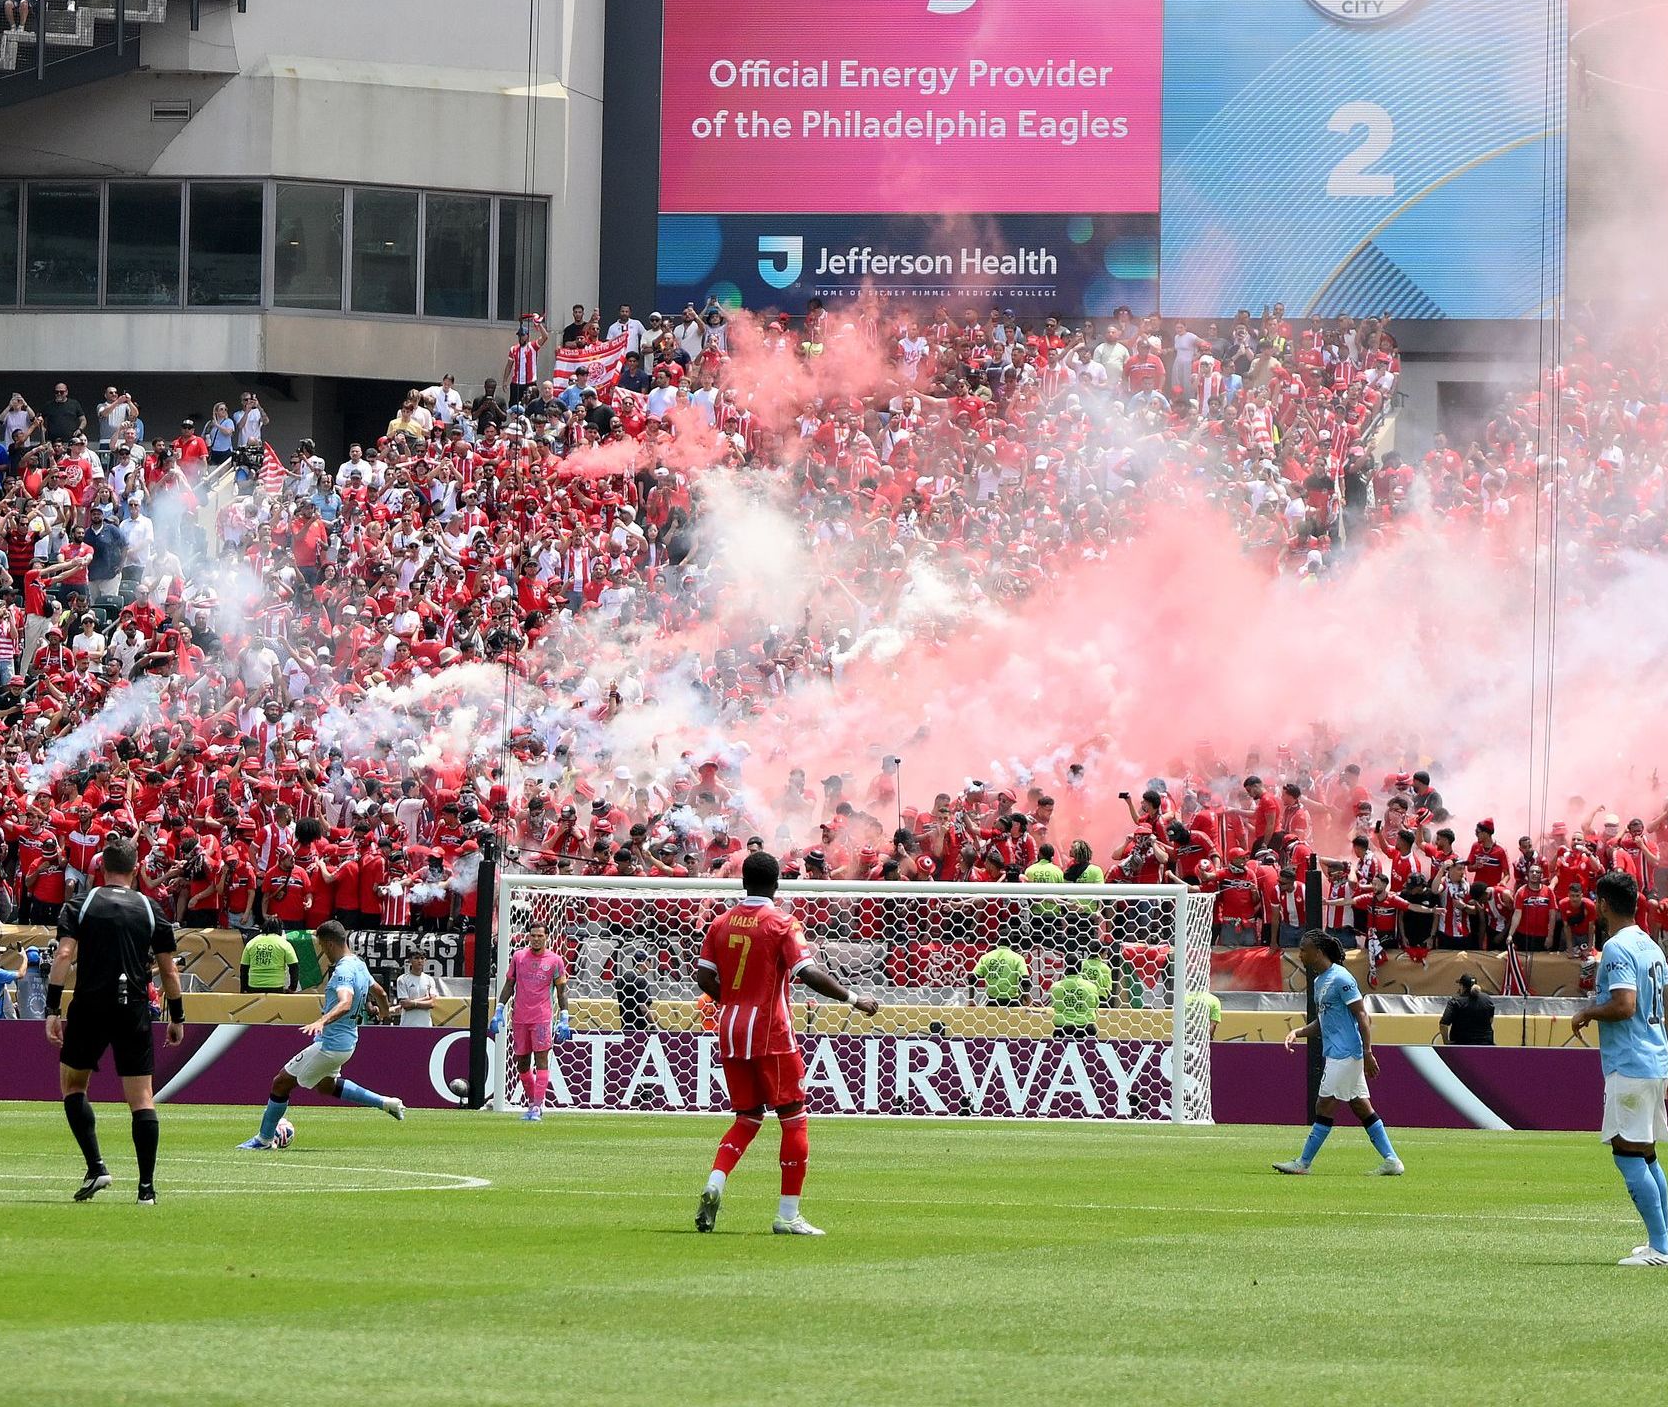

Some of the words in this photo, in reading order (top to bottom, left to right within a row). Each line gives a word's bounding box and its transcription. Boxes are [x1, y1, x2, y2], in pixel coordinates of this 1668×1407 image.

[709, 57, 830, 89] Official
[839, 59, 959, 95] Energy
[968, 58, 1114, 89] Provider
[691, 110, 728, 139] of
[733, 110, 795, 139] the
[801, 109, 1008, 146] Philadelphia
[1015, 110, 1129, 146] Eagles
[1325, 100, 1396, 197] 2
[815, 245, 956, 277] Jefferson
[959, 246, 1058, 275] Health
[728, 914, 759, 928] MALSA
[348, 932, 460, 956] ULTRAS
[728, 933, 752, 991] 7
